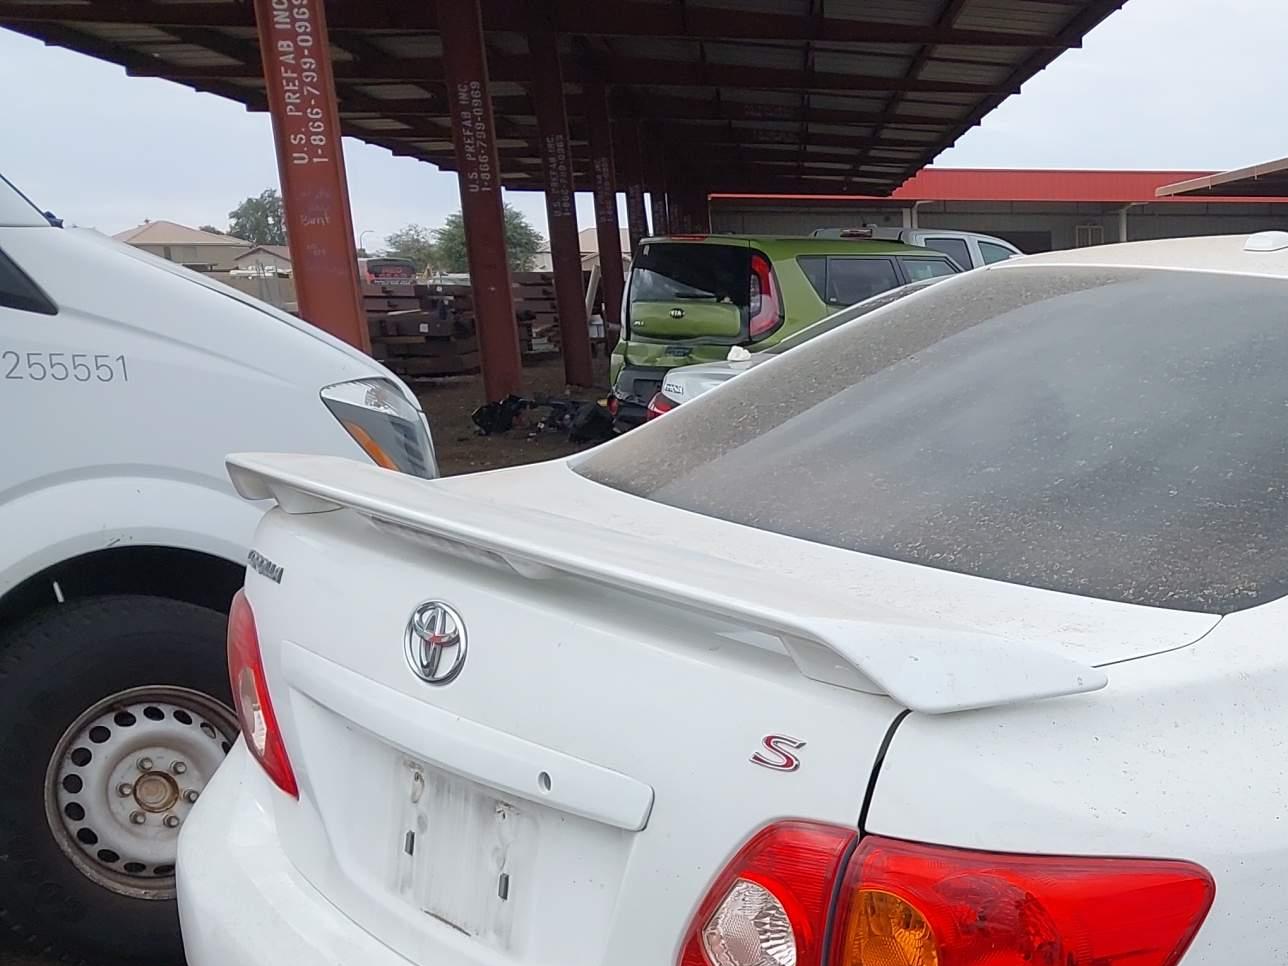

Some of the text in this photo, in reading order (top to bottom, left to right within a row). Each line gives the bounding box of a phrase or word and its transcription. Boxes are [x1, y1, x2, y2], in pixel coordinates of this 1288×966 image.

[277, 40, 303, 116] PREFAB
[290, 128, 309, 165] U.S.
[460, 111, 476, 161] PREFAB
[467, 168, 480, 192] U.S.
[2, 351, 128, 382] 255551
[748, 734, 807, 773] S
